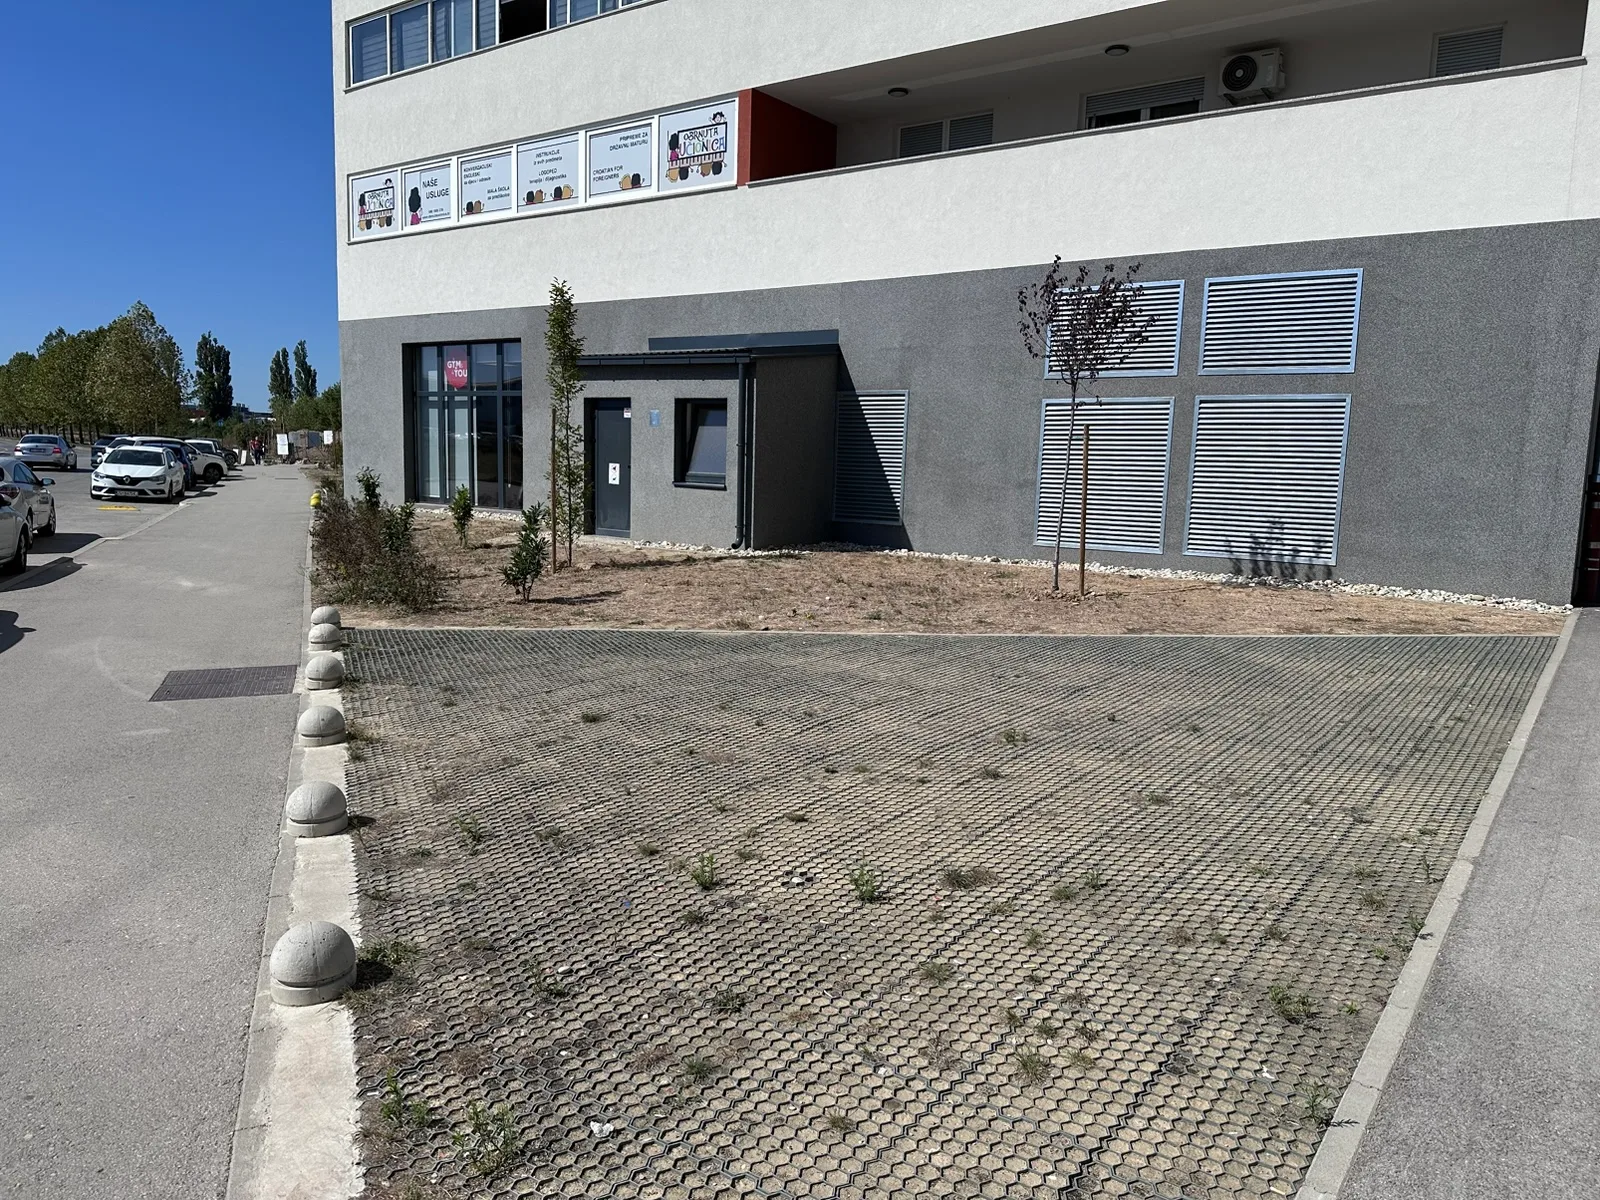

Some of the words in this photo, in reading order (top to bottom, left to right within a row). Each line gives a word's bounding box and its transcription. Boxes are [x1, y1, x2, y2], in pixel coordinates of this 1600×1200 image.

[683, 127, 719, 141] OBRNUTA
[679, 136, 725, 156] UČIONICA
[422, 177, 438, 188] NAŠE
[425, 188, 449, 199] USLUGE
